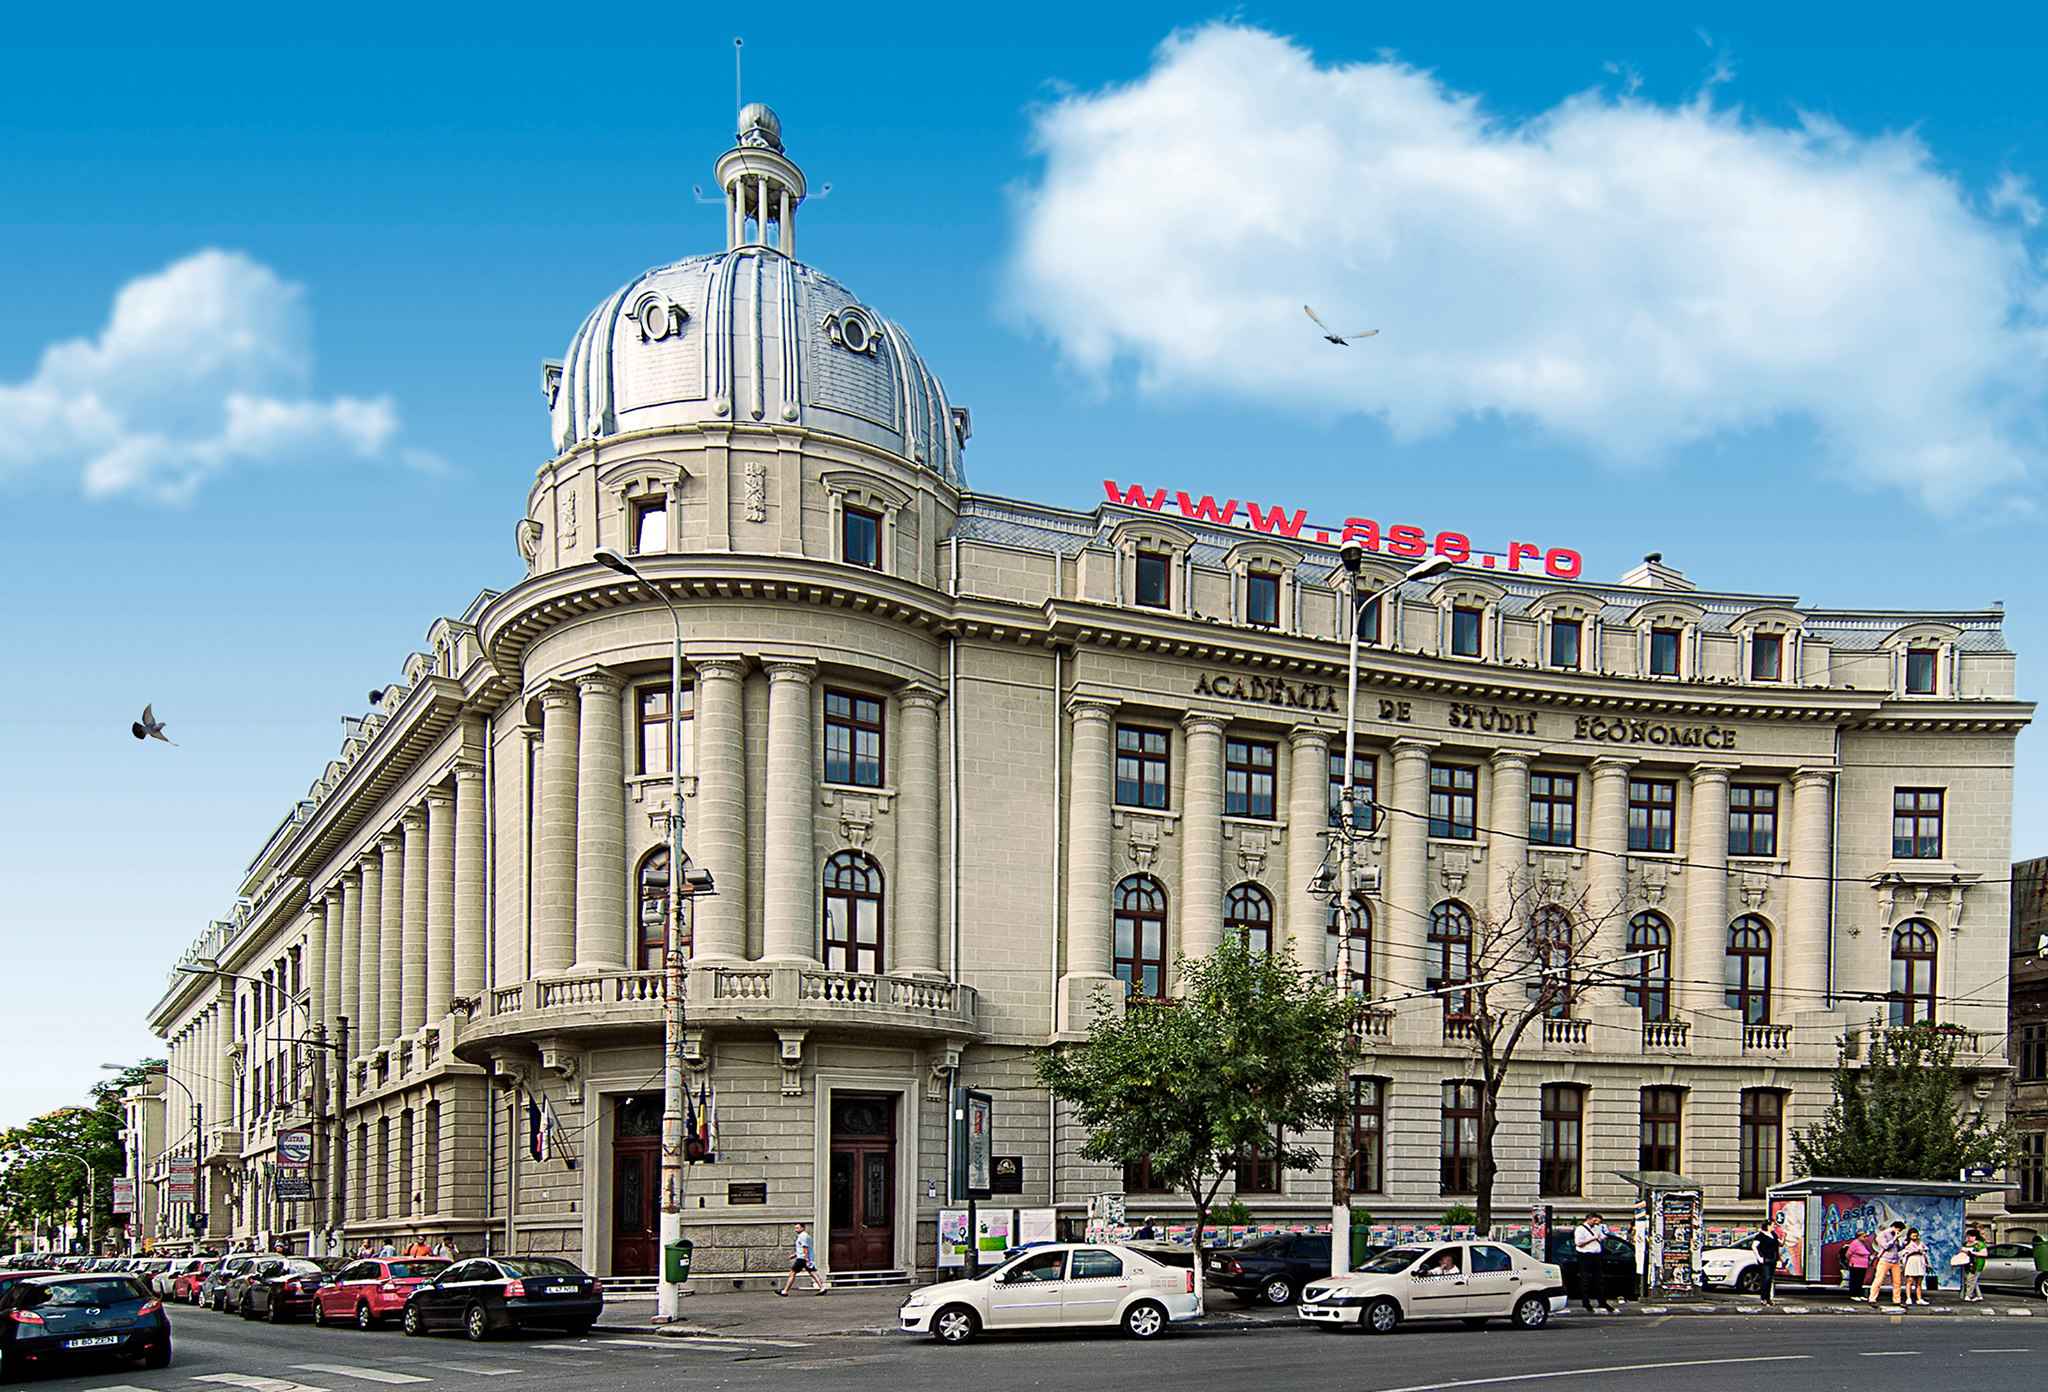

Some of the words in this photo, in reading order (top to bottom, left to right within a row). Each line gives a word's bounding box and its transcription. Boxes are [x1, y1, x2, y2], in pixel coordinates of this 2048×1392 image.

[1104, 479, 1582, 579] www.ase.ro
[1378, 699, 1413, 722] DE
[1448, 703, 1539, 735] STUDII
[1574, 714, 1738, 750] ECONOMICE
